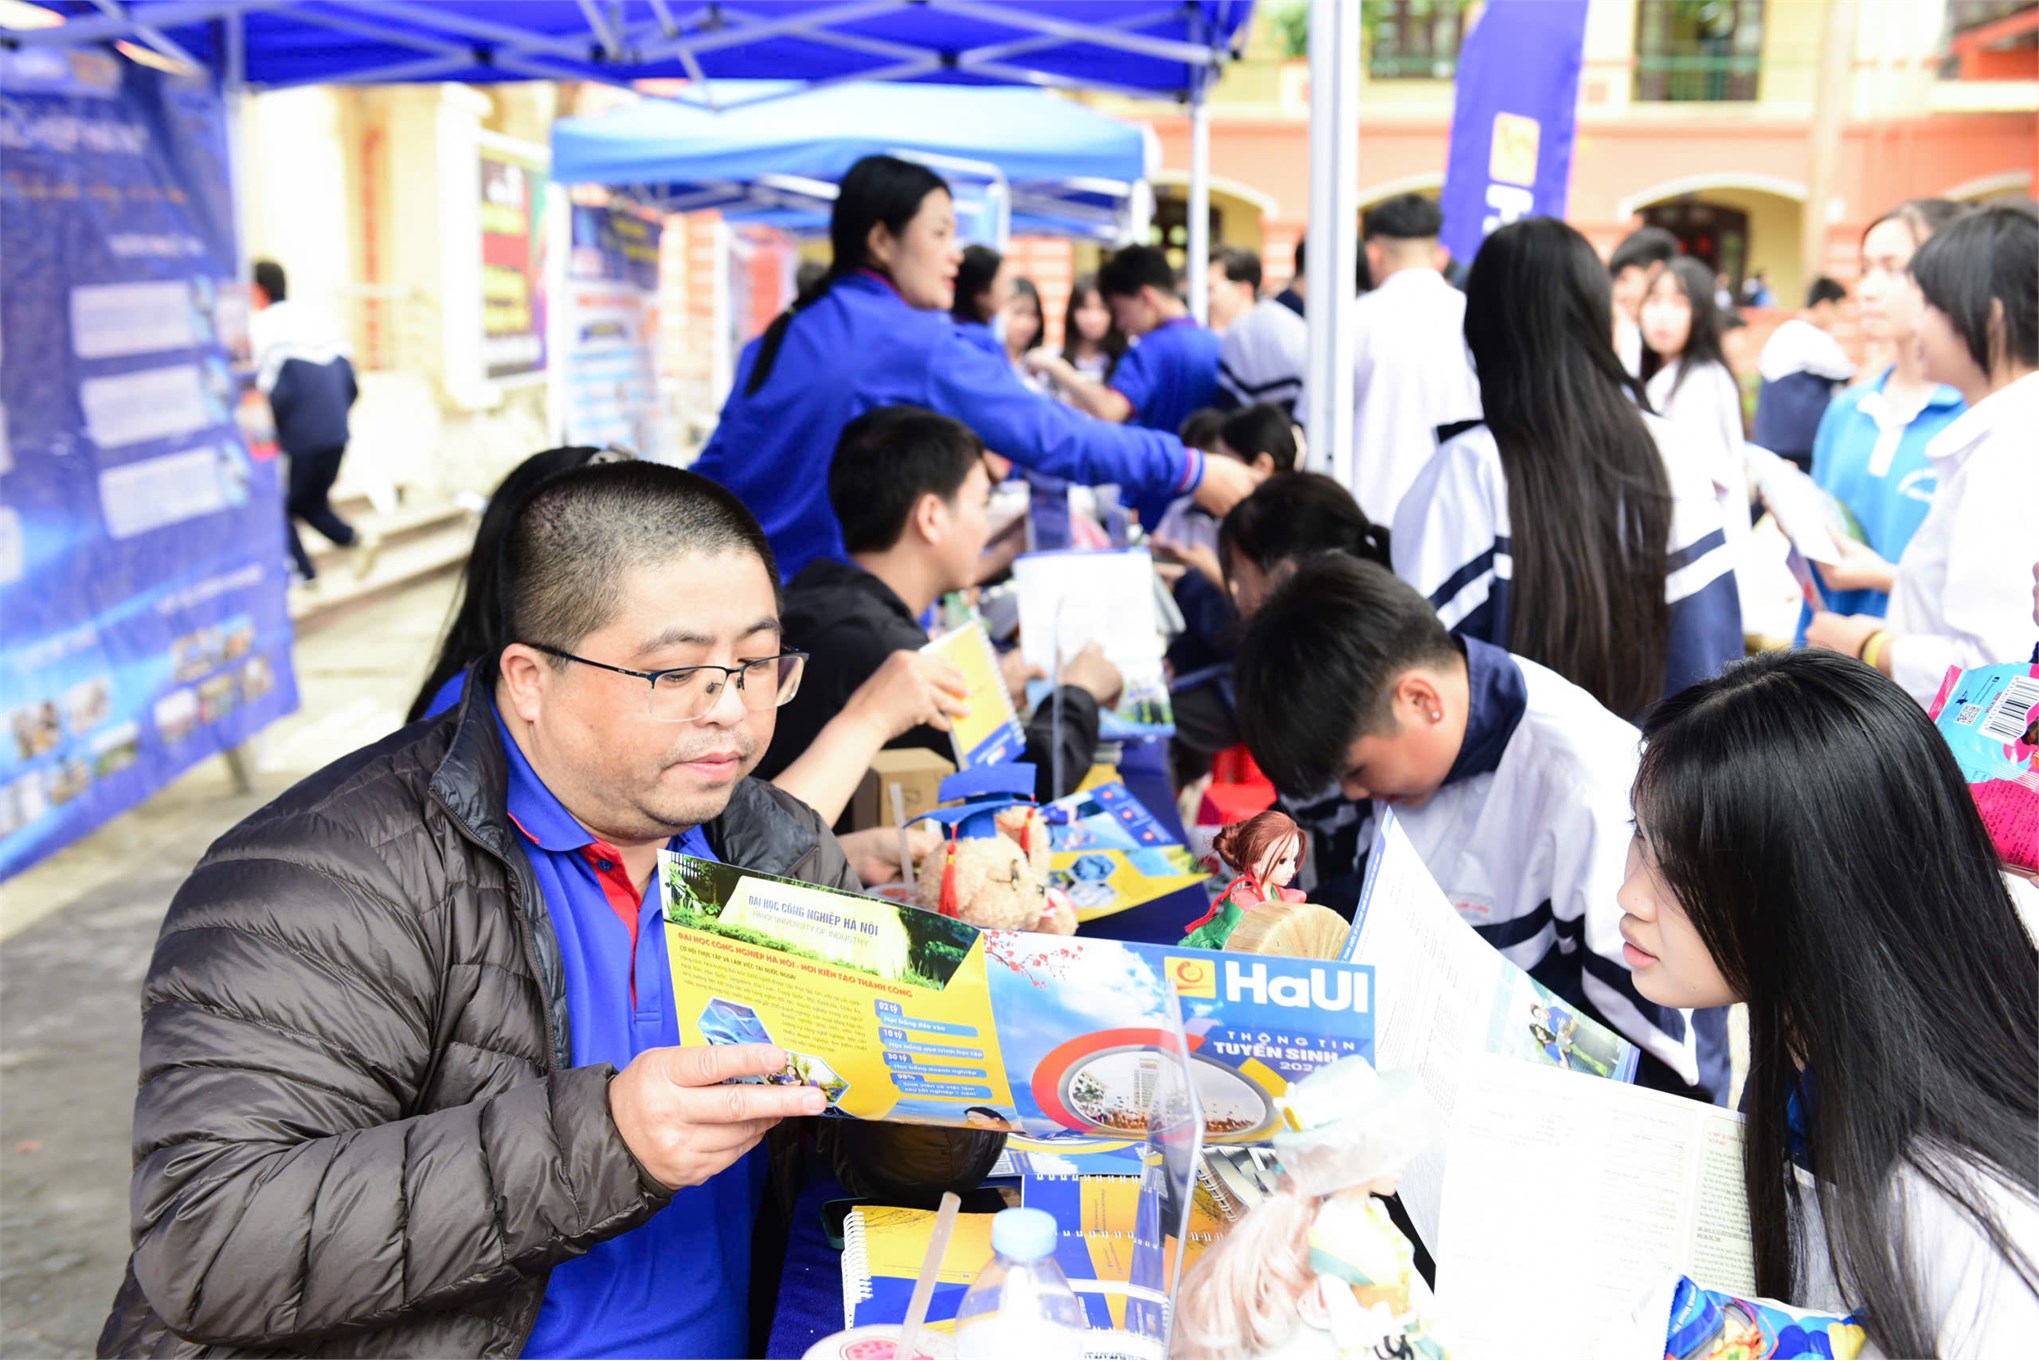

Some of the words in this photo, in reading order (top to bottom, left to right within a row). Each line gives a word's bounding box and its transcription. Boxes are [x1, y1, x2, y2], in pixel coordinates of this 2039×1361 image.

[781, 902, 805, 918] CÔNG
[807, 908, 841, 928] NGHIỆP
[859, 921, 879, 938] NỘI
[1225, 960, 1369, 1013] HaUI
[878, 1002, 889, 1011] 02
[883, 1029, 893, 1037] 10
[1227, 1031, 1309, 1047] THÔNG
[1318, 1039, 1356, 1051] TIN
[887, 1053, 897, 1061] 30
[1285, 1048, 1339, 1063] SINH
[1279, 1061, 1321, 1073] 202
